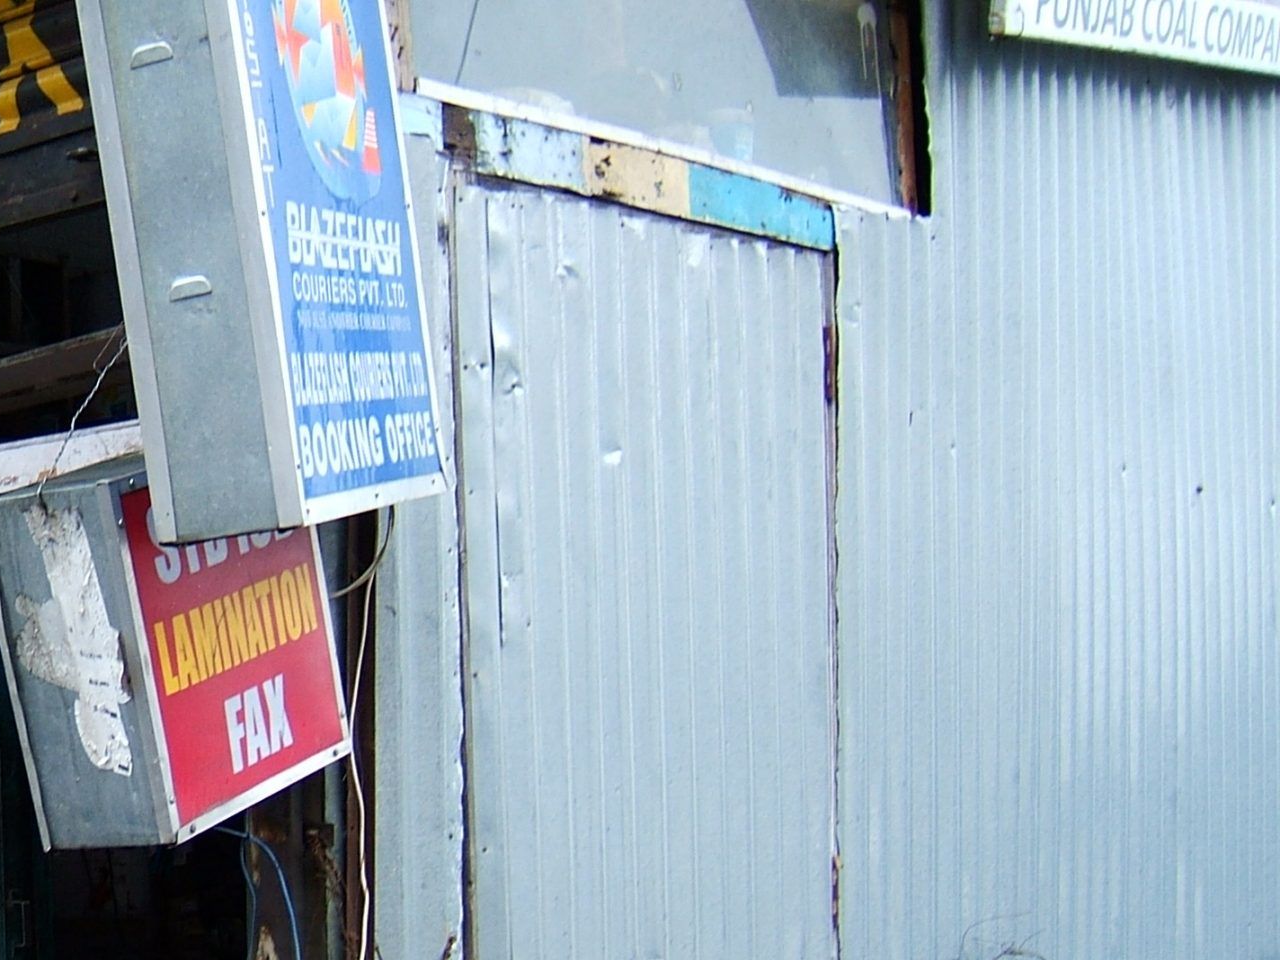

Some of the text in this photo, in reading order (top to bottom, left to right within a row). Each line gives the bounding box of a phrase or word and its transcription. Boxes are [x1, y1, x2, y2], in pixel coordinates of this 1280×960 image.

[1036, 0, 1134, 37] PUNJAB
[1142, 0, 1196, 48] COAL
[286, 200, 402, 277] BLAZEFLASH
[292, 272, 408, 309] COURIERS PVT. LTD.
[298, 410, 435, 478] BOOKING OFFICE
[153, 563, 318, 697] LAMINATION
[224, 674, 294, 775] FAX
